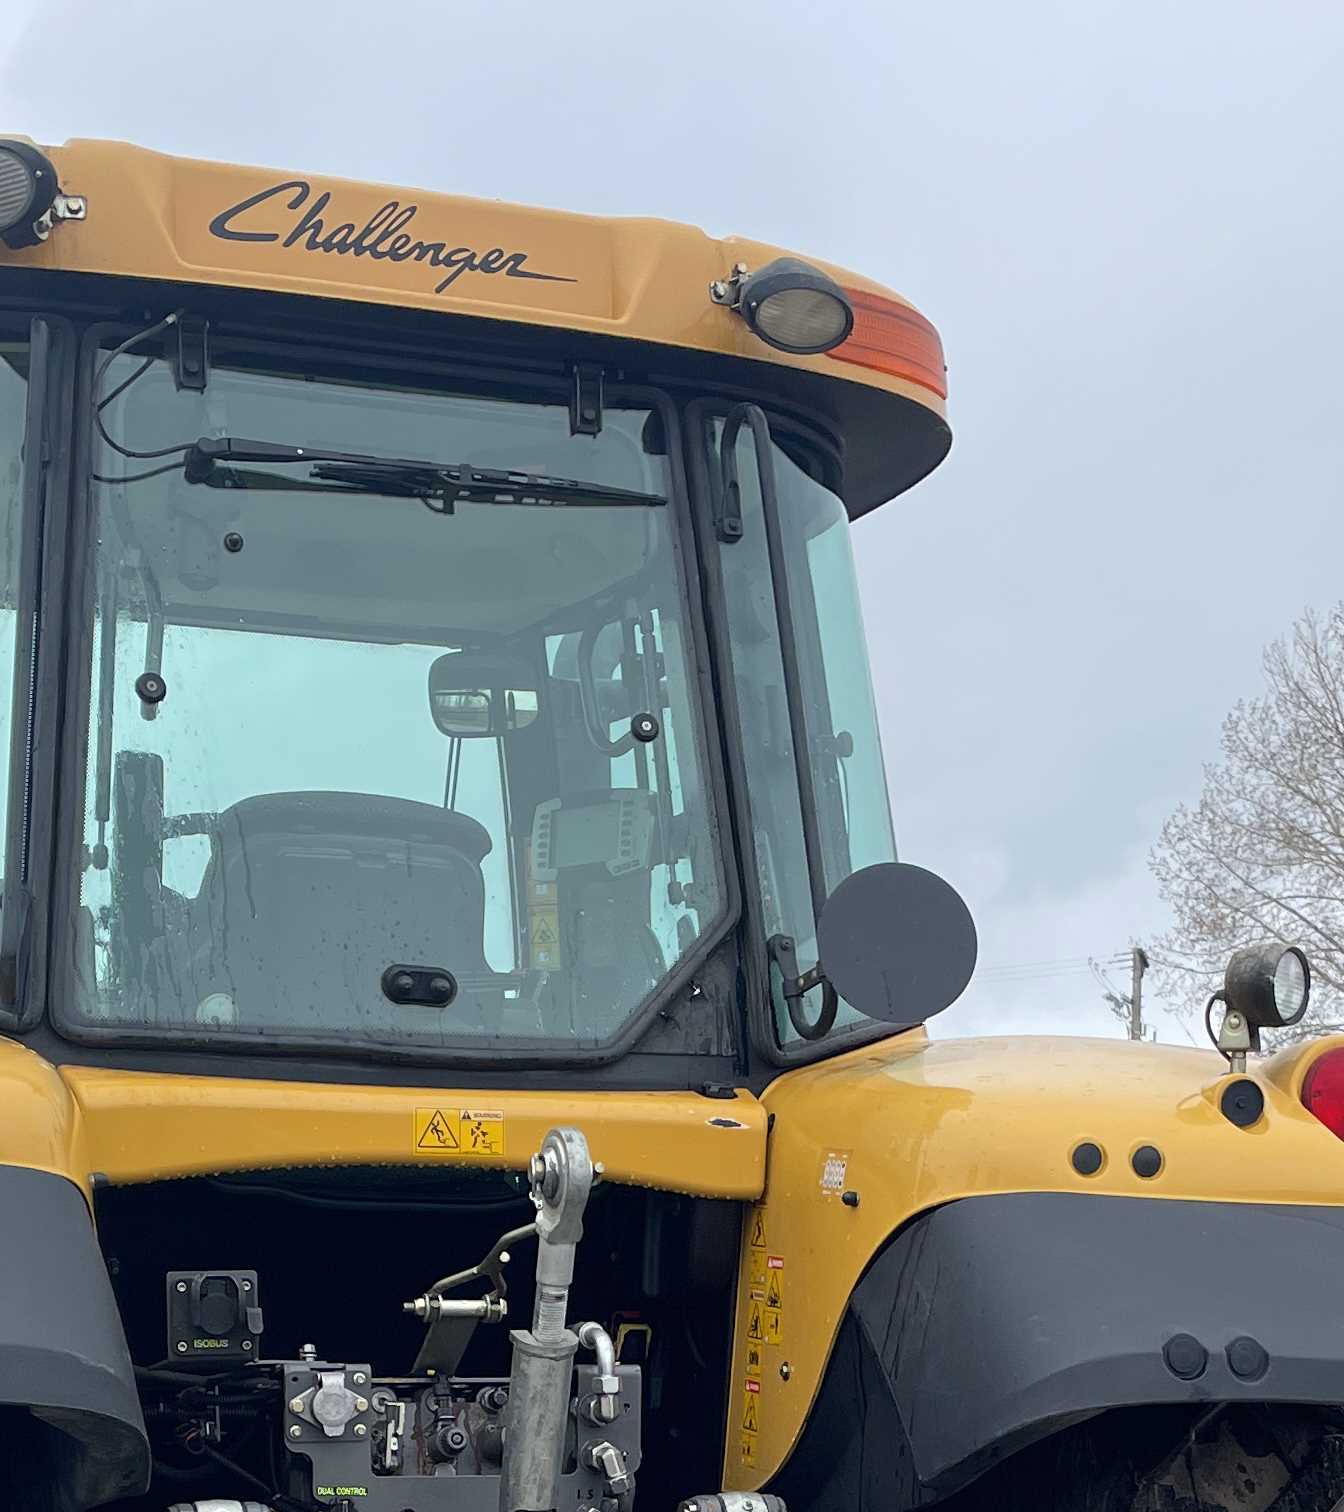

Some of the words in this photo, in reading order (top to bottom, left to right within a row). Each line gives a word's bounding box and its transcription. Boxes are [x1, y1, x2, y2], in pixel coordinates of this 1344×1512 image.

[209, 181, 579, 293] Challenger
[193, 1339, 229, 1348] ISOBUS
[317, 1487, 335, 1496] DUAL
[336, 1487, 368, 1496] CONTROL
